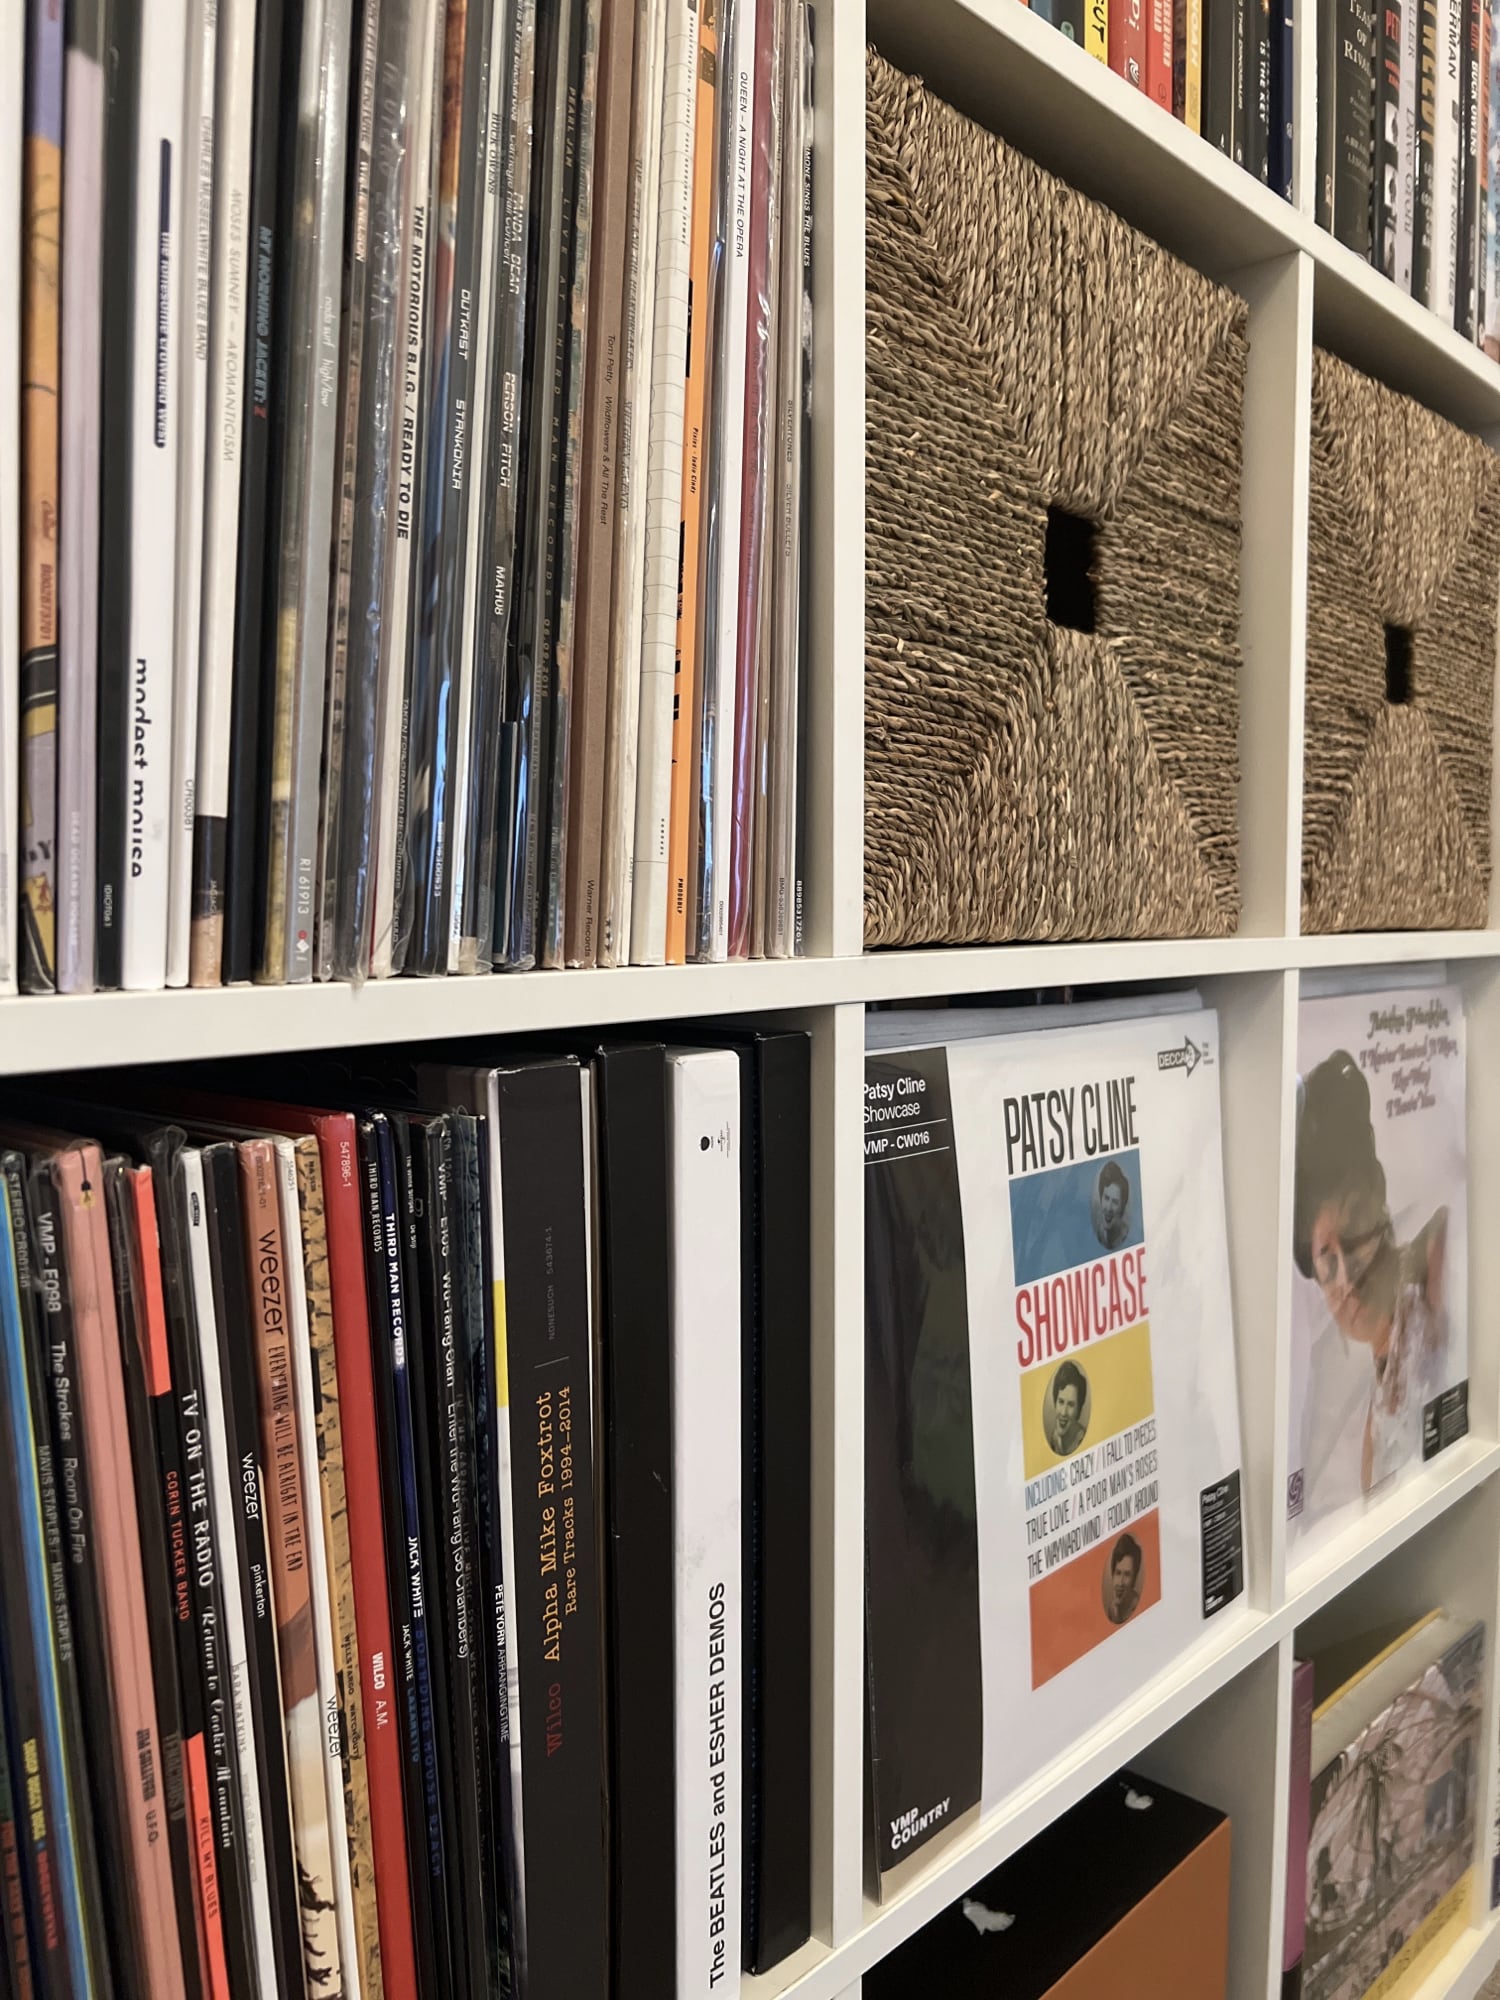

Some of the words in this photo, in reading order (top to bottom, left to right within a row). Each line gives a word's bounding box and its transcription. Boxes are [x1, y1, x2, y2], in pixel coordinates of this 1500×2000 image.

[739, 72, 748, 112] QUEEN
[737, 136, 746, 172] NIGHT
[737, 175, 745, 191] AT
[737, 193, 745, 215] THE
[230, 189, 241, 241] MOSES
[258, 226, 272, 248] MY
[413, 205, 424, 238] THE
[510, 192, 524, 242] PANDA
[736, 218, 744, 258] OPERA
[228, 248, 240, 314] SUMNEY
[256, 254, 271, 337] MORNING
[406, 244, 422, 345] NOTORIOUS
[508, 254, 521, 294] BEAR
[323, 296, 335, 324] nada
[458, 289, 470, 360] OUTKAST
[322, 326, 334, 347] surf
[606, 334, 616, 356] Tom
[254, 339, 269, 401] JACKET:
[319, 358, 332, 407] high/low
[405, 351, 418, 397] B.I.G.
[604, 357, 615, 384] Petty
[223, 339, 237, 462] AROMANTICISM
[502, 372, 515, 433] PERSON
[401, 417, 413, 476] READY
[451, 398, 466, 490] STANKONIA
[602, 396, 613, 452] Wildflowers
[499, 443, 512, 488] PITCH
[602, 465, 610, 478] All
[400, 482, 411, 503] TO
[601, 481, 609, 498] The
[397, 510, 410, 540] DIE
[600, 504, 608, 525] Rest
[493, 566, 506, 616] MAH08
[134, 657, 151, 770] modest
[132, 779, 144, 878] mouse
[585, 879, 594, 914] Warner
[584, 917, 593, 957] Records
[1159, 1052, 1186, 1069] DECCA
[897, 1074, 926, 1095] Cline
[864, 1101, 920, 1124] Showcase
[1003, 1087, 1075, 1176] PATSY
[1080, 1076, 1140, 1154] CLINE
[340, 1142, 351, 1187] 547896-1
[864, 1137, 888, 1156] VMP
[897, 1130, 930, 1149] CW016
[368, 1162, 379, 1189] THIRD
[370, 1192, 380, 1210] MAN
[37, 1212, 55, 1253] VMP
[371, 1213, 382, 1252] RECORDS
[385, 1213, 397, 1256] THIRD
[43, 1269, 62, 1312] E098
[259, 1229, 285, 1336] weezer
[388, 1261, 399, 1294] MAN
[547, 1285, 556, 1340] NONESUCH
[1015, 1248, 1148, 1368] SHOWCASE
[391, 1299, 405, 1366] RECORDS
[51, 1341, 66, 1373] The
[269, 1345, 291, 1411] EVERYTHING
[55, 1377, 73, 1441] Strokes
[181, 1390, 198, 1418] TV
[184, 1428, 202, 1460] ON
[273, 1414, 293, 1442] WILL
[536, 1391, 554, 1498] Foxtrot
[38, 1445, 54, 1485] MAVIS
[277, 1445, 295, 1460] BE
[1070, 1452, 1095, 1487] CRAZY
[1106, 1440, 1123, 1465] FALL
[1124, 1436, 1133, 1457] TO
[1133, 1419, 1157, 1453] PIECES
[63, 1457, 80, 1504] Room
[166, 1471, 182, 1516] CORIN
[189, 1468, 208, 1511] THE
[241, 1452, 260, 1520] weezer
[278, 1462, 298, 1507] ALRIGHT
[1026, 1515, 1048, 1546] TRUE
[1049, 1499, 1070, 1535] LOVE
[1078, 1494, 1084, 1514] A
[1085, 1482, 1107, 1510] POOR
[1135, 1449, 1158, 1485] ROSES
[42, 1488, 60, 1546] STAPLES
[68, 1507, 83, 1531] On
[283, 1512, 299, 1525] IN
[562, 1497, 576, 1563] Tracks
[1028, 1551, 1043, 1580] THE
[1044, 1530, 1082, 1570] WAYWARD
[1082, 1516, 1100, 1547] WIND
[1134, 1480, 1158, 1512] AROUND
[71, 1534, 86, 1564] Fire
[171, 1520, 186, 1576] TUCKER
[193, 1519, 214, 1586] RADIO
[284, 1530, 301, 1550] THE
[286, 1553, 304, 1572] END
[408, 1536, 420, 1569] JACK
[540, 1506, 558, 1576] Mike
[50, 1561, 66, 1601] MAVIS
[177, 1581, 191, 1620] BAND
[250, 1564, 267, 1618] pinkerton
[410, 1572, 423, 1618] WHITE
[494, 1584, 504, 1611] PETE
[564, 1568, 578, 1615] Rare
[54, 1604, 72, 1661] STAPLES
[202, 1606, 219, 1669] Return
[402, 1624, 412, 1647] JACK
[496, 1613, 506, 1645] YORN
[541, 1583, 562, 1661] Alpha
[708, 1582, 725, 1676] DEMOS
[207, 1674, 219, 1690] to
[232, 1665, 243, 1696] SARA
[372, 1652, 386, 1690] WILCO
[404, 1650, 414, 1681] WHITE
[375, 1699, 389, 1730] A.M.
[497, 1648, 510, 1743] ARRANGINGTIME
[208, 1698, 225, 1756] Cookie
[234, 1700, 247, 1754] WATKINS
[328, 1695, 342, 1759] weezer
[545, 1683, 563, 1756] Wilco
[708, 1681, 725, 1768] ESHER
[422, 1741, 438, 1804] HOUSE
[710, 1771, 726, 1816] and
[215, 1762, 233, 1847] Mountain
[890, 1807, 918, 1834] VMP
[891, 1797, 950, 1850] COUNTRY
[198, 1817, 210, 1849] KILL
[428, 1814, 442, 1877] REACH
[202, 1854, 213, 1872] MY
[709, 1821, 725, 1938] BEATLES
[204, 1875, 218, 1919] BLUES
[709, 1939, 726, 1989] The
